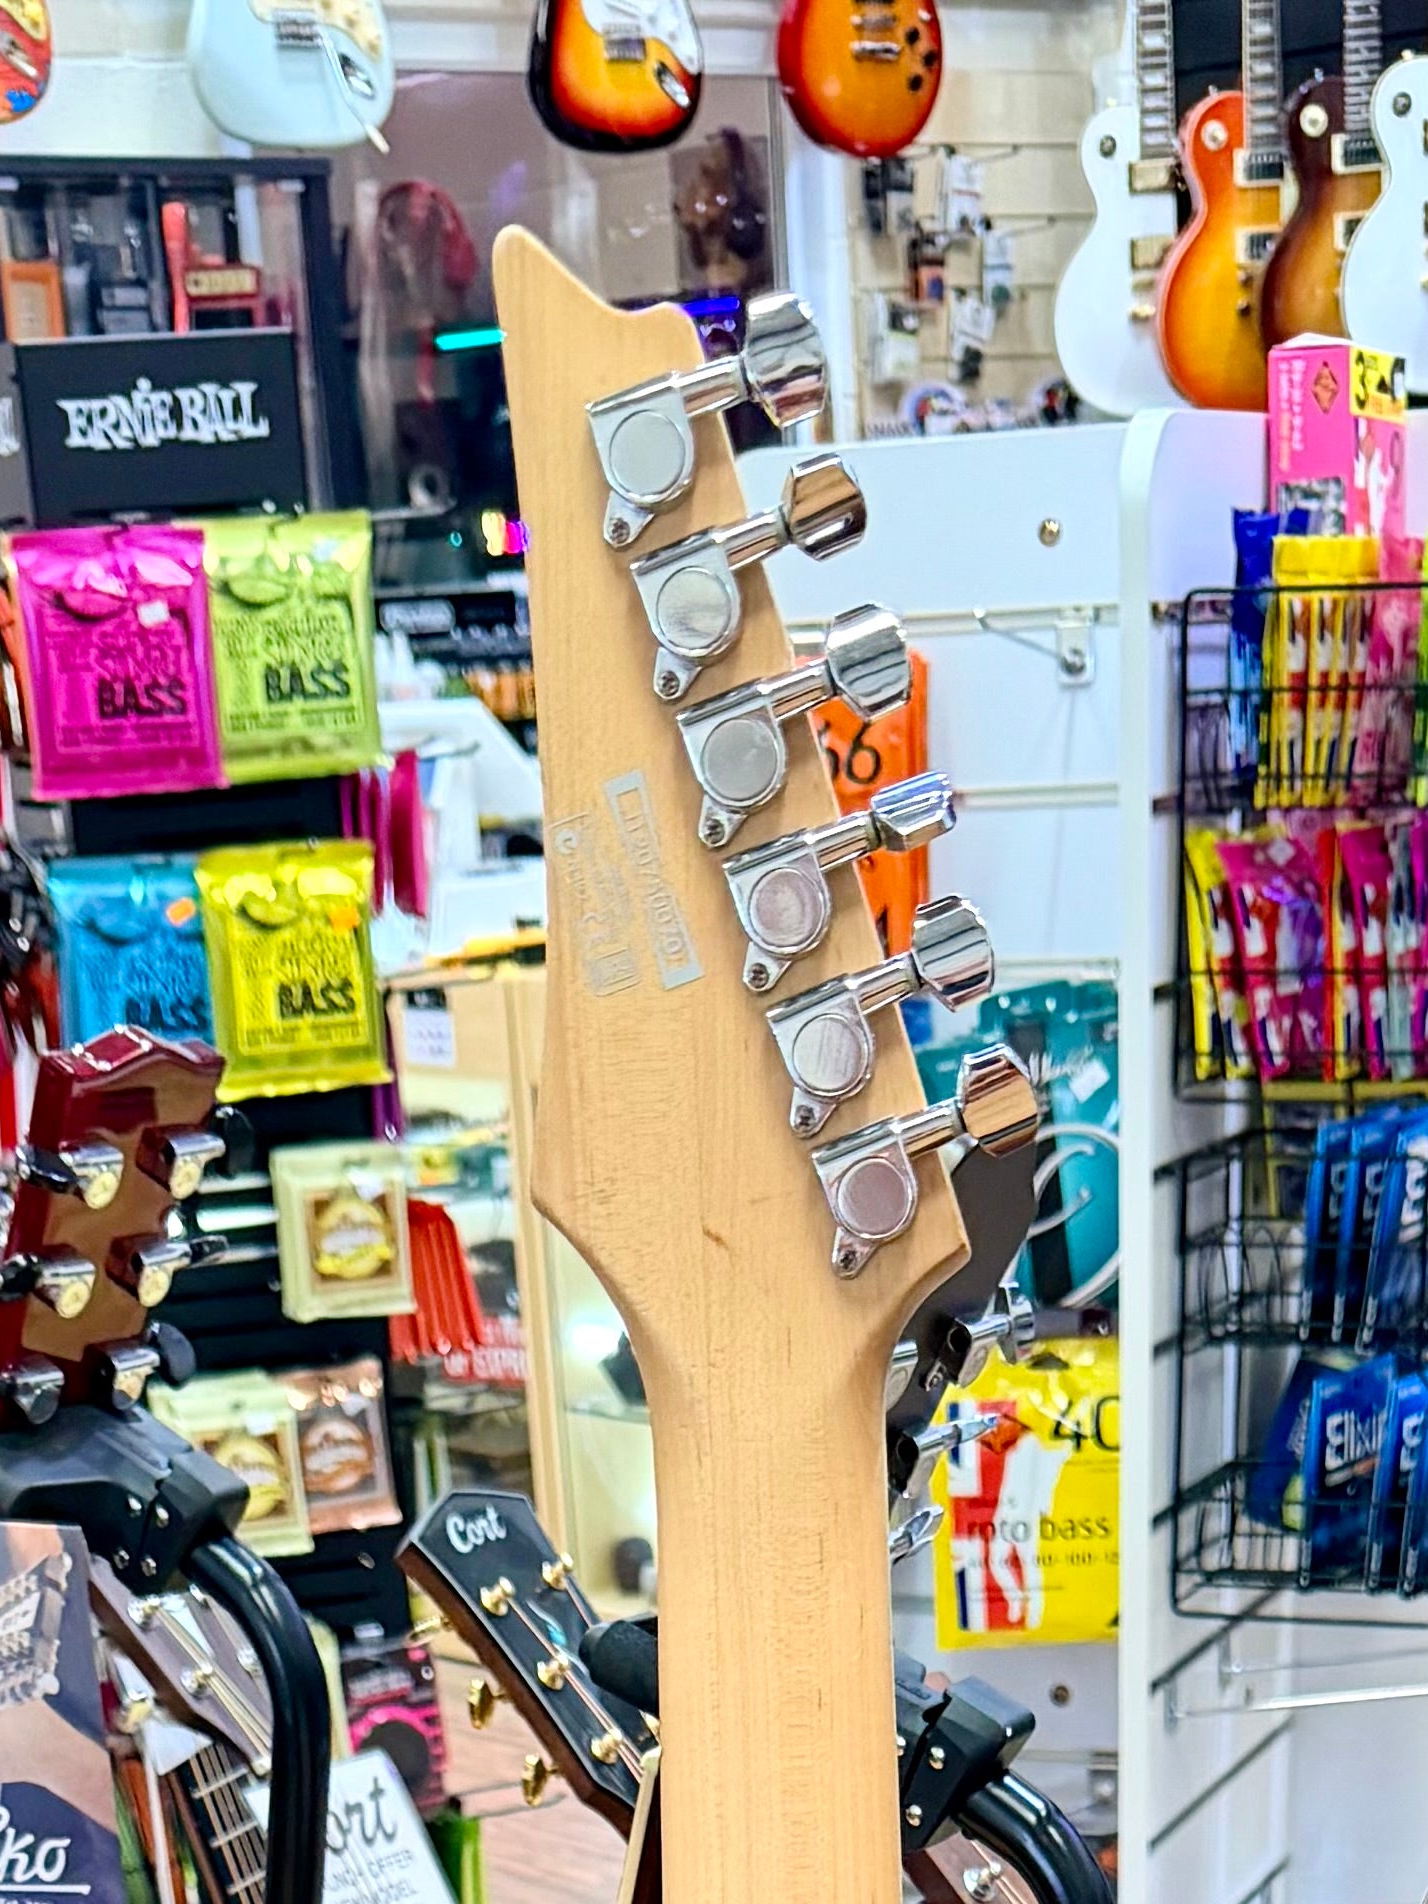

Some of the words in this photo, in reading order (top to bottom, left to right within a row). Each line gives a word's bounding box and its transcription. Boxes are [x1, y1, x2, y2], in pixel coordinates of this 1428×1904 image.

[174, 381, 270, 443] BALL
[97, 677, 187, 719] BASS
[264, 659, 351, 702] BASS
[125, 995, 209, 1036] BASS
[278, 977, 356, 1020] BASS
[1054, 1394, 1121, 1451] 40
[445, 1503, 508, 1554] Cort
[966, 1518, 1031, 1544] roto
[1038, 1509, 1111, 1543] bass
[325, 1776, 398, 1858] ort
